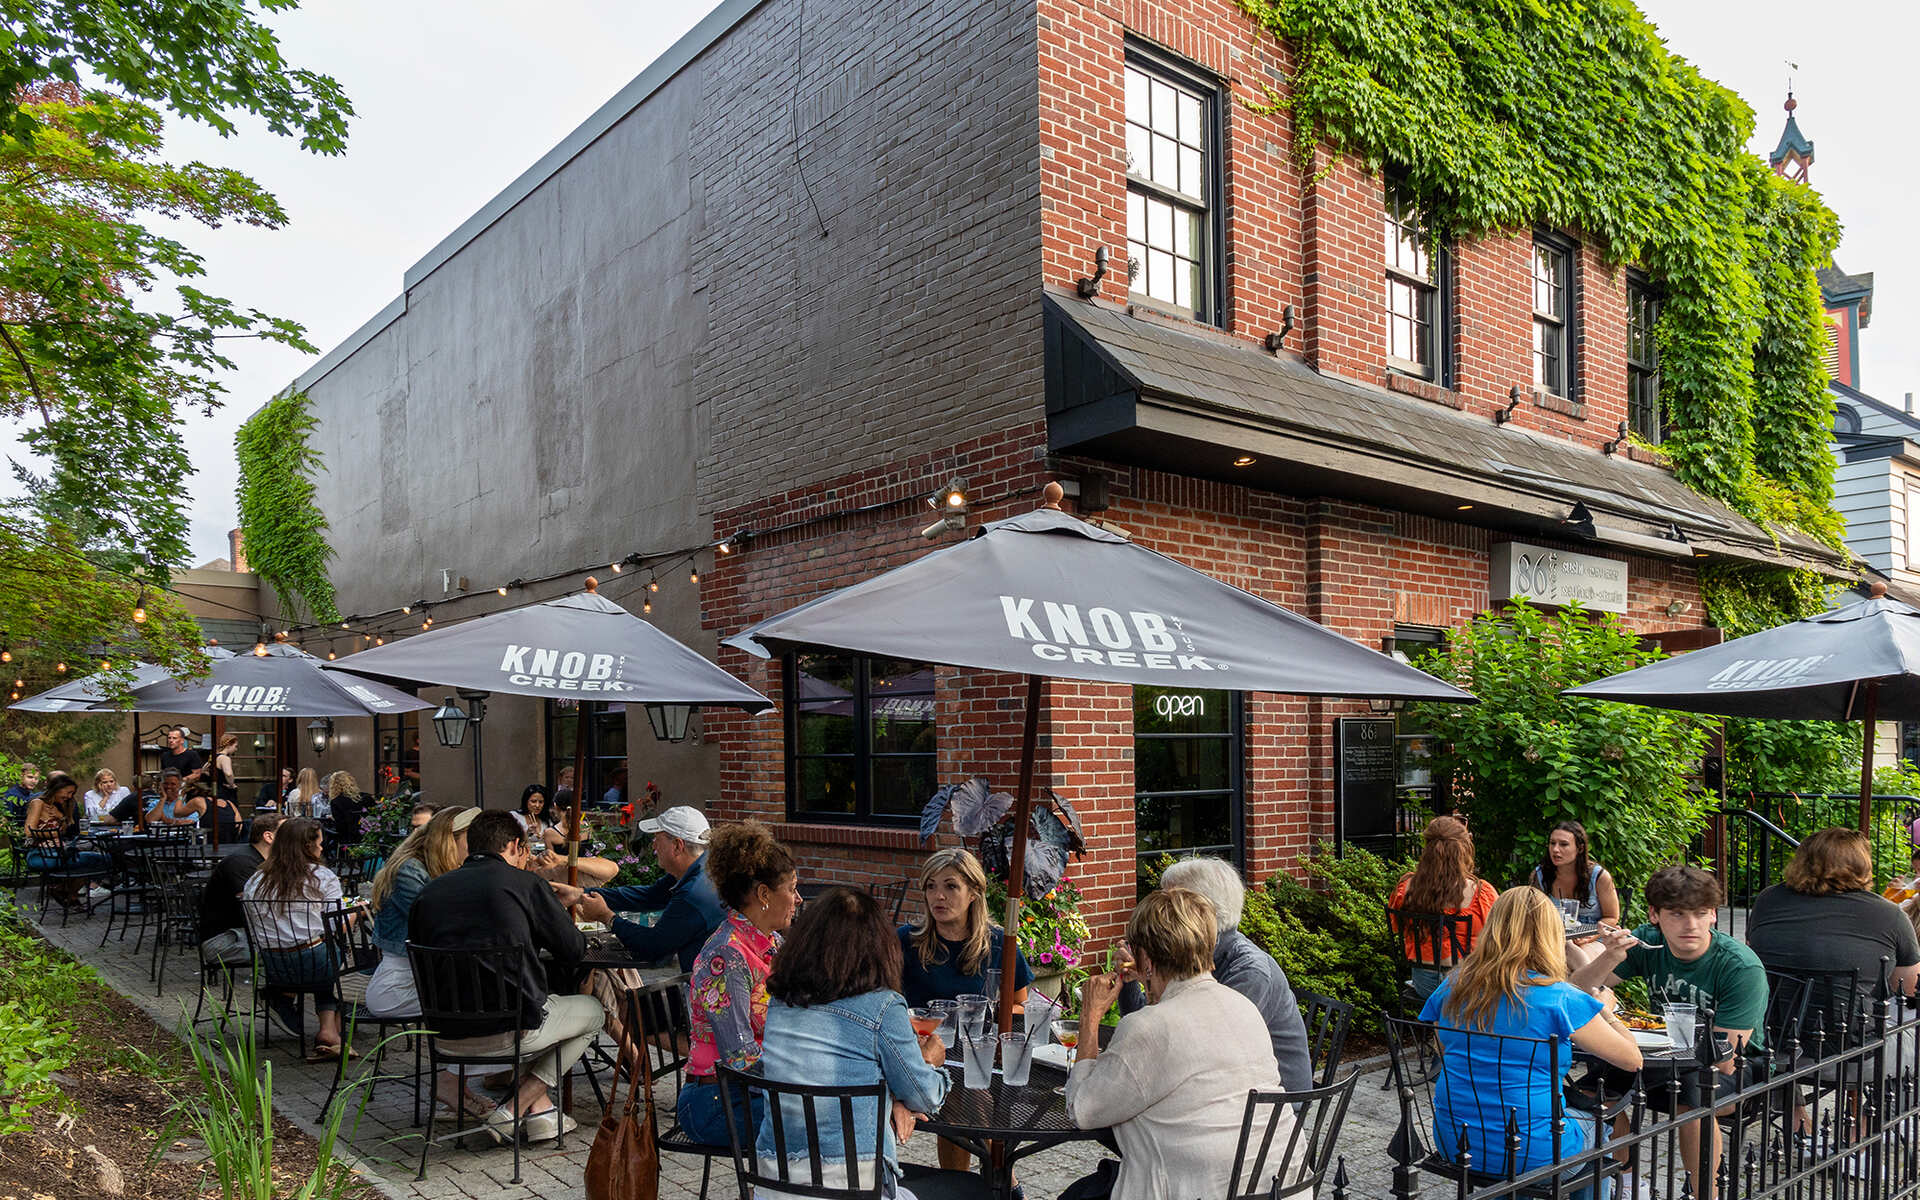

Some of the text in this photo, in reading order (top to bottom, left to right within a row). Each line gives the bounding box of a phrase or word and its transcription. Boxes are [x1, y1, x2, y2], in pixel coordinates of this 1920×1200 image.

[1516, 552, 1547, 596] 86
[1000, 595, 1177, 653] KNOB
[500, 644, 614, 680] KNOB
[1708, 655, 1824, 682] KNOB
[206, 684, 282, 704] KNOB
[210, 703, 286, 712] CREEK
[1156, 695, 1204, 722] open
[1361, 724, 1374, 740] 86
